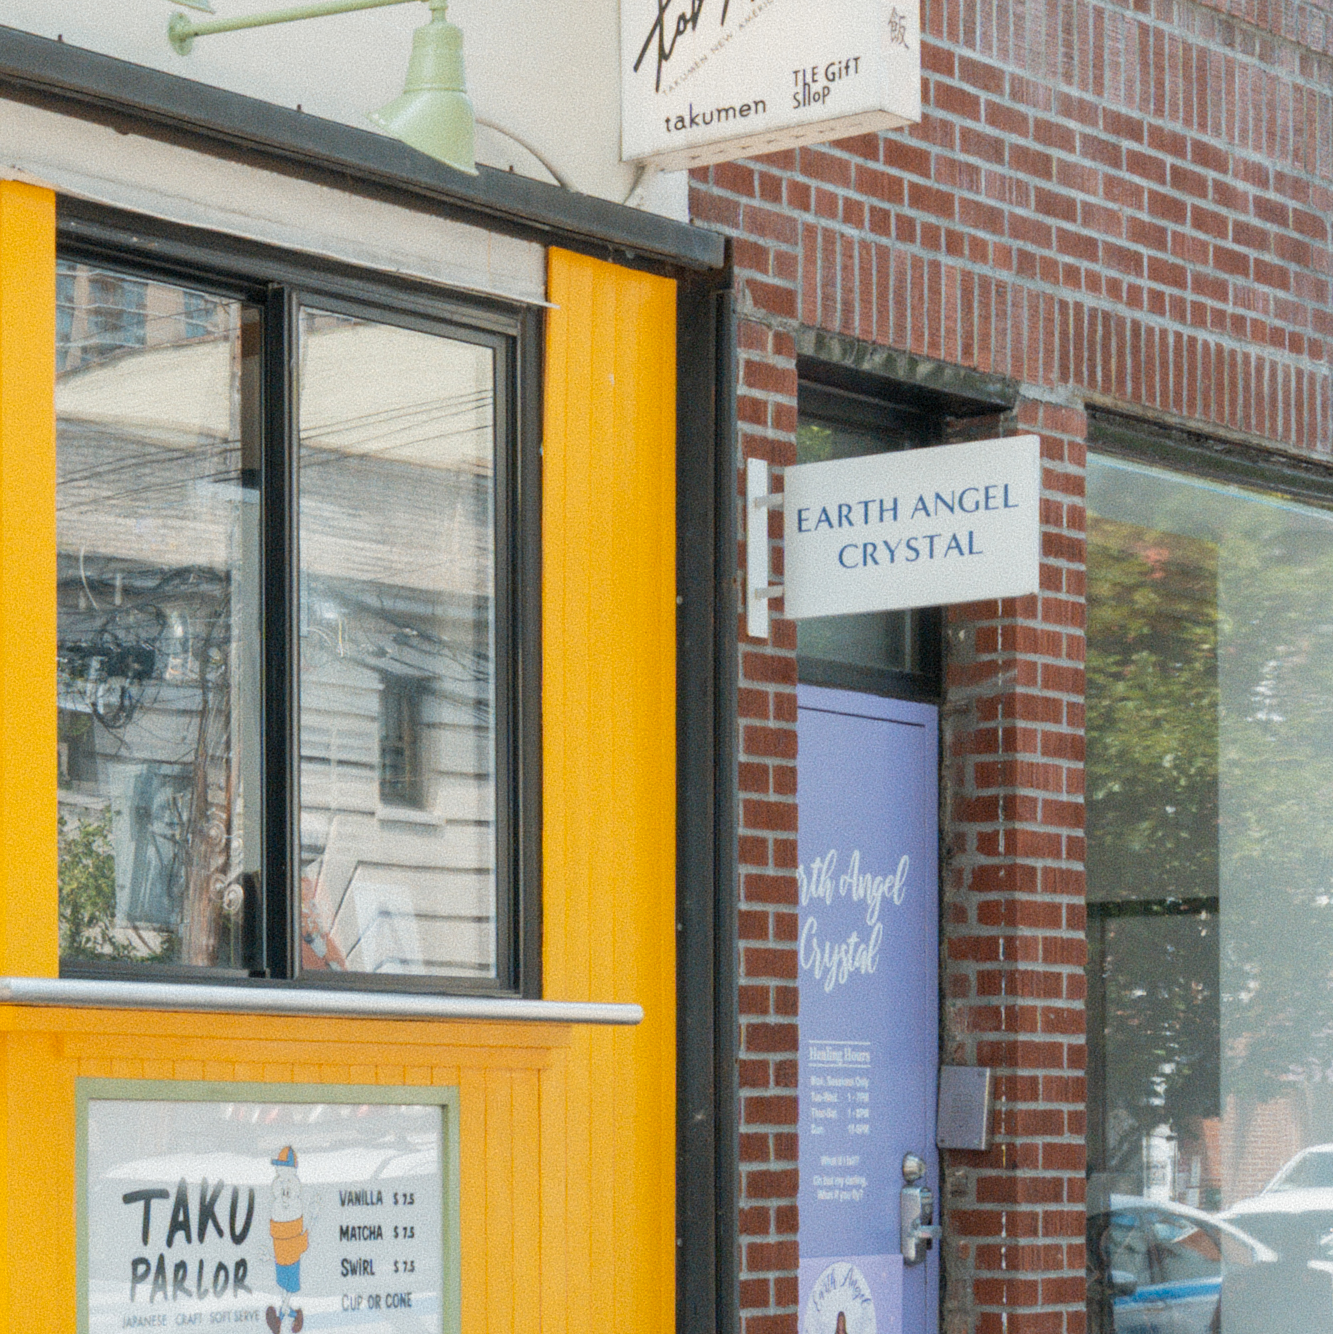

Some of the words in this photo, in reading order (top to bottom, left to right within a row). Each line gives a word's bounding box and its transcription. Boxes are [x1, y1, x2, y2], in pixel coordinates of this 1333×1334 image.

[710, 32, 733, 54] NEW
[665, 99, 767, 134] takumen
[796, 496, 899, 534] EARTH
[910, 483, 1019, 520] ANGEL
[837, 529, 984, 569] CRYSTAL
[839, 849, 909, 927] Angel
[800, 916, 883, 993] Crystal
[809, 1046, 843, 1065] Healing
[844, 1047, 871, 1062] Hours
[121, 1177, 256, 1249] TAKU
[338, 1224, 384, 1243] MATCHA
[130, 1253, 253, 1304] PARLOR
[122, 1313, 168, 1329] JAPANESE
[175, 1312, 203, 1327] CRAFT
[209, 1312, 232, 1325] SOFT
[233, 1310, 261, 1324] SERVE
[341, 1293, 363, 1312] CUP
[367, 1293, 383, 1311] OR
[385, 1291, 413, 1310] CONE
